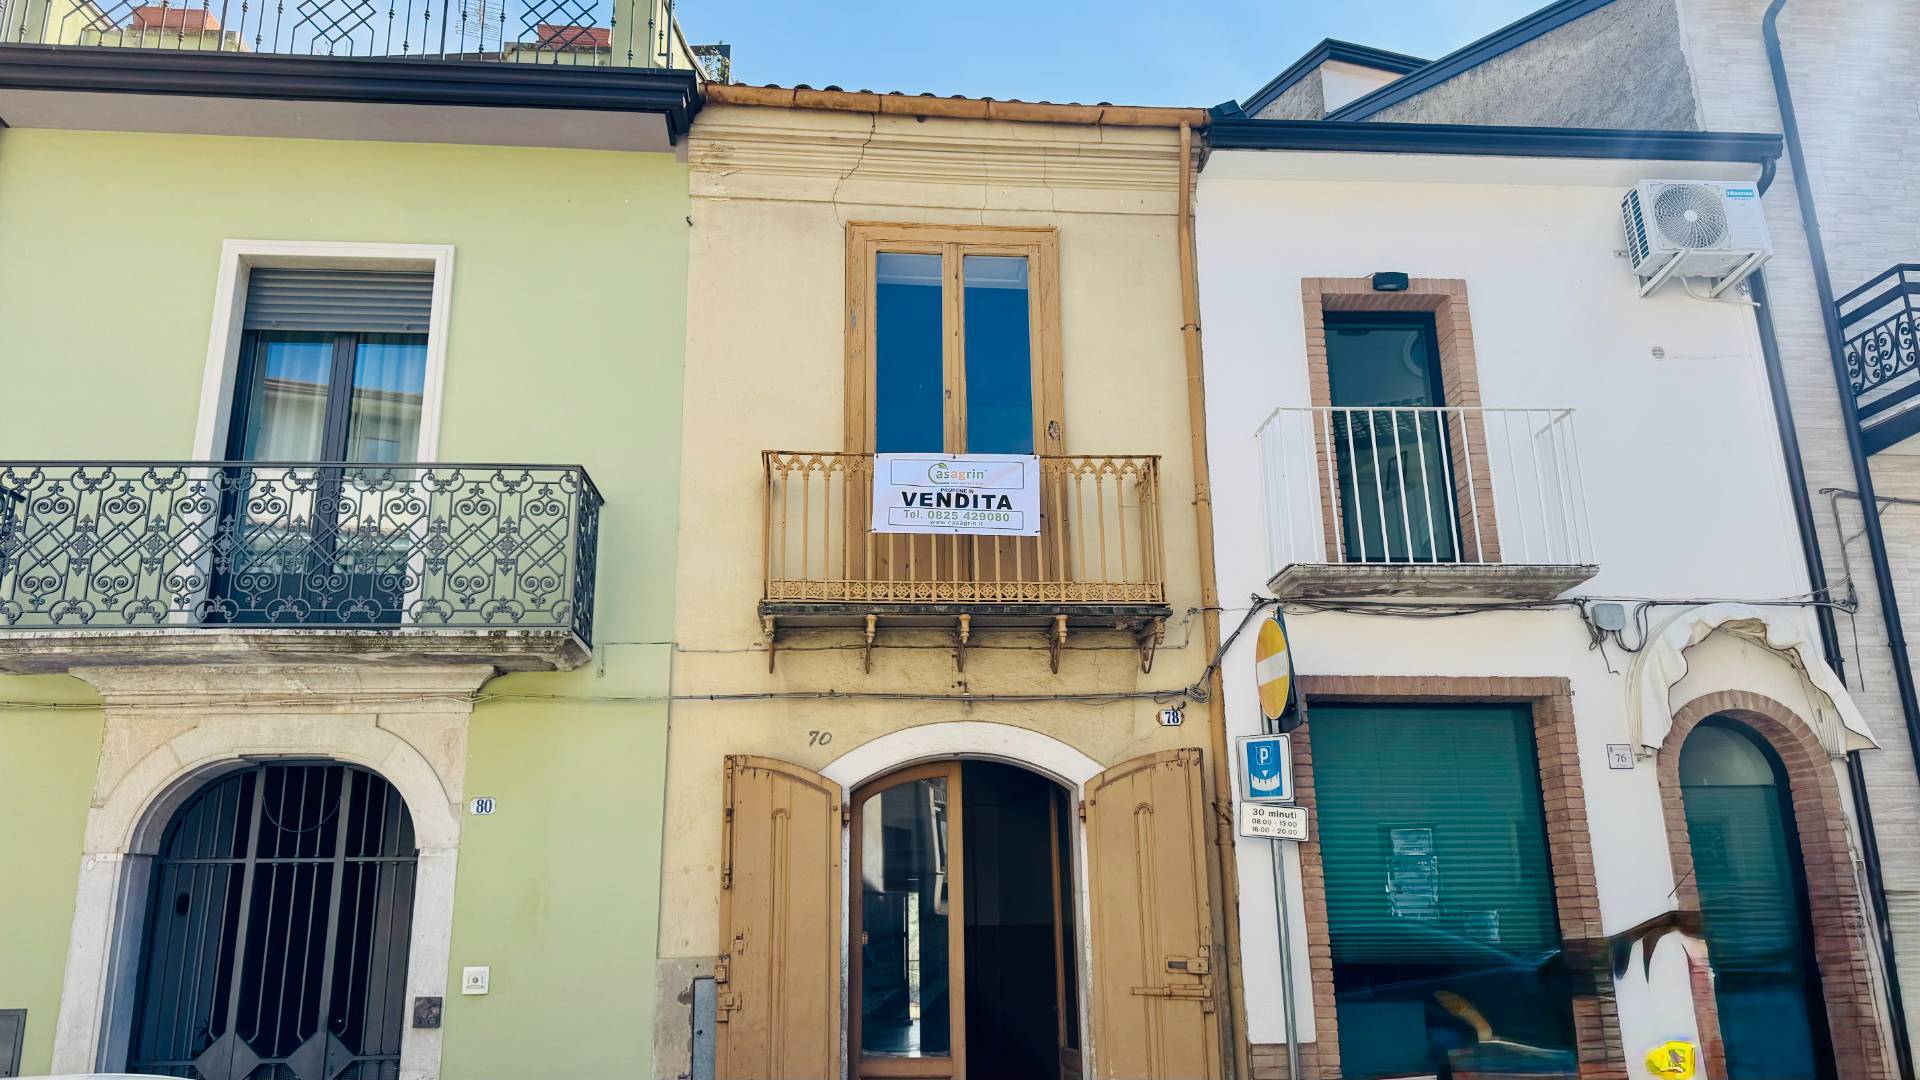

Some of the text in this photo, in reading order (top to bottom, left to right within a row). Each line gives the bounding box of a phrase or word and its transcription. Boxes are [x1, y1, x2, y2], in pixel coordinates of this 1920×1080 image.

[902, 491, 1012, 510] VENDITA
[904, 510, 1010, 522] Tel. 0825 429080
[1164, 711, 1179, 724] 78
[808, 730, 832, 748] 70
[1260, 748, 1268, 764] P
[1616, 754, 1626, 762] 76
[476, 799, 492, 813] 80
[1268, 810, 1296, 818] minuti
